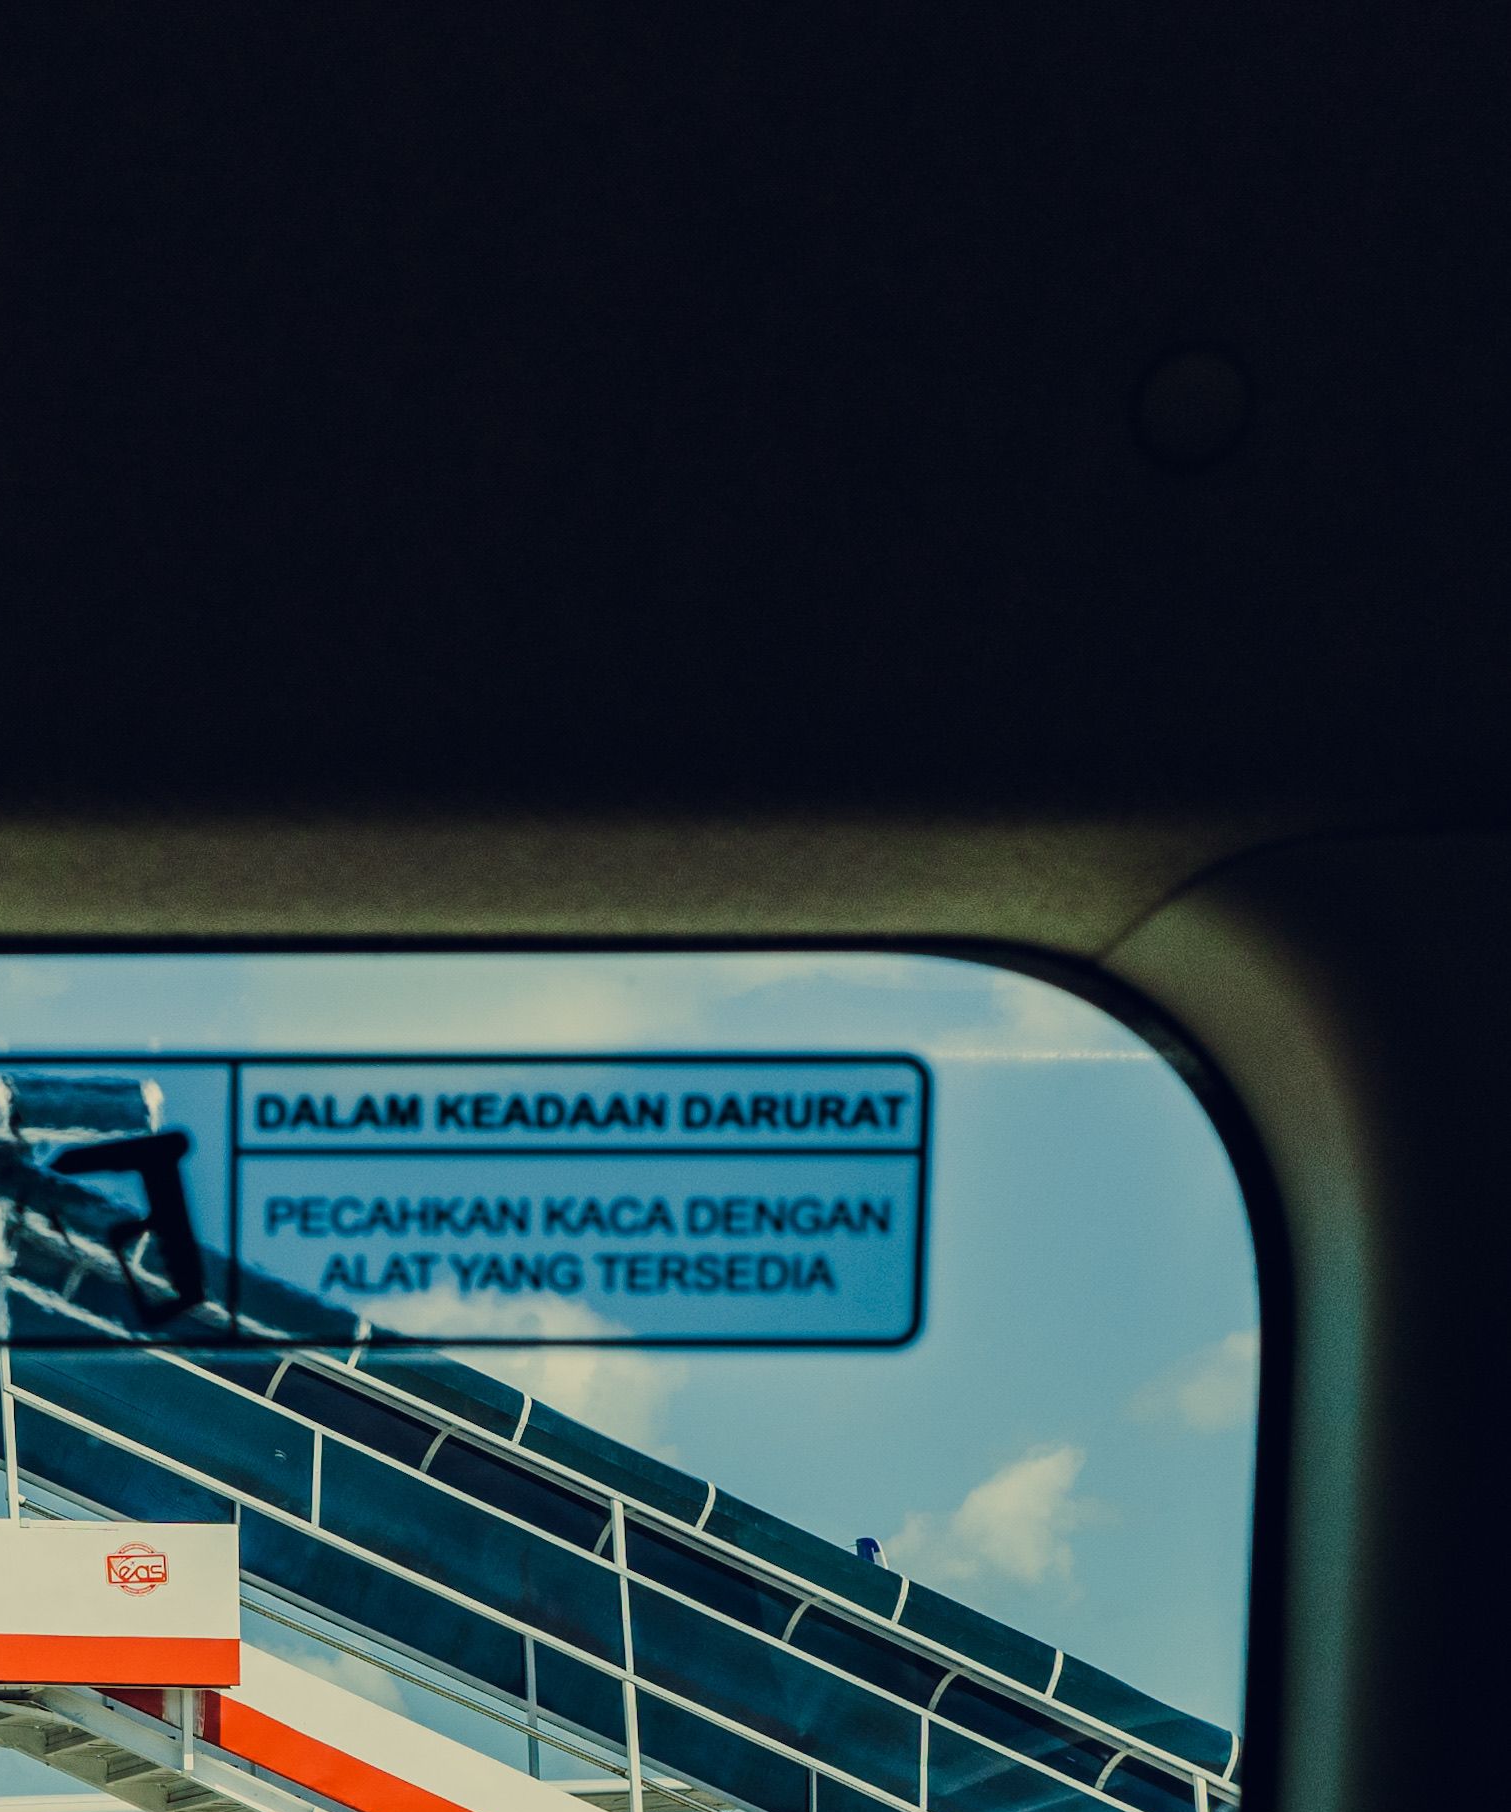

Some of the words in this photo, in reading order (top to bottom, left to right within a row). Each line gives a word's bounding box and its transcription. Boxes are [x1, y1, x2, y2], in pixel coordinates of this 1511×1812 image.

[258, 1095, 422, 1129] DALAM
[436, 1095, 666, 1129] KEADAAN
[683, 1095, 906, 1129] DARURAT
[265, 1197, 528, 1236] PECAHKAN
[543, 1197, 676, 1236] KACA
[687, 1197, 891, 1236] DENGAN
[320, 1253, 439, 1293] ALAT
[449, 1253, 583, 1293] YANG
[594, 1253, 836, 1293] TERSEDIA
